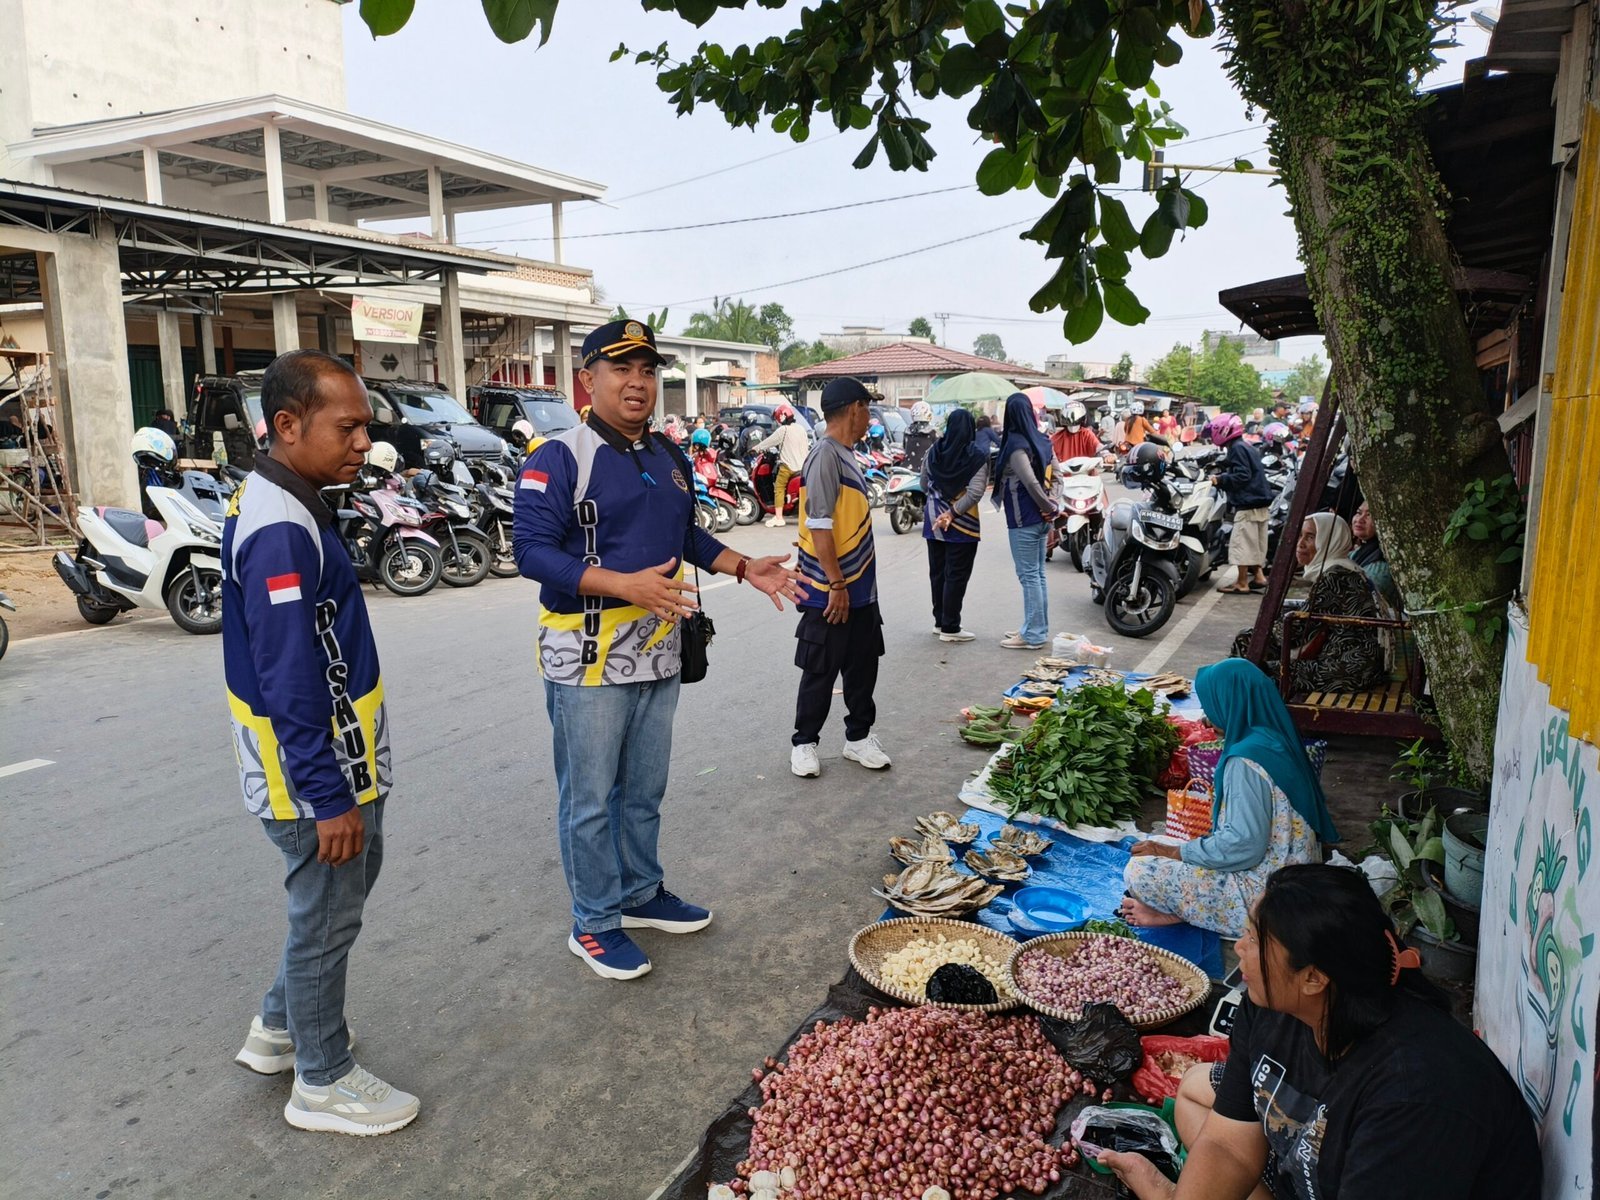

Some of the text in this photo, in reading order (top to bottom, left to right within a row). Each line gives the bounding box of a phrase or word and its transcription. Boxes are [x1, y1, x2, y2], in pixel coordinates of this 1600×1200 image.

[363, 306, 413, 321] VERSION
[316, 599, 375, 795] DISHUB
[1254, 1064, 1271, 1088] CDL
